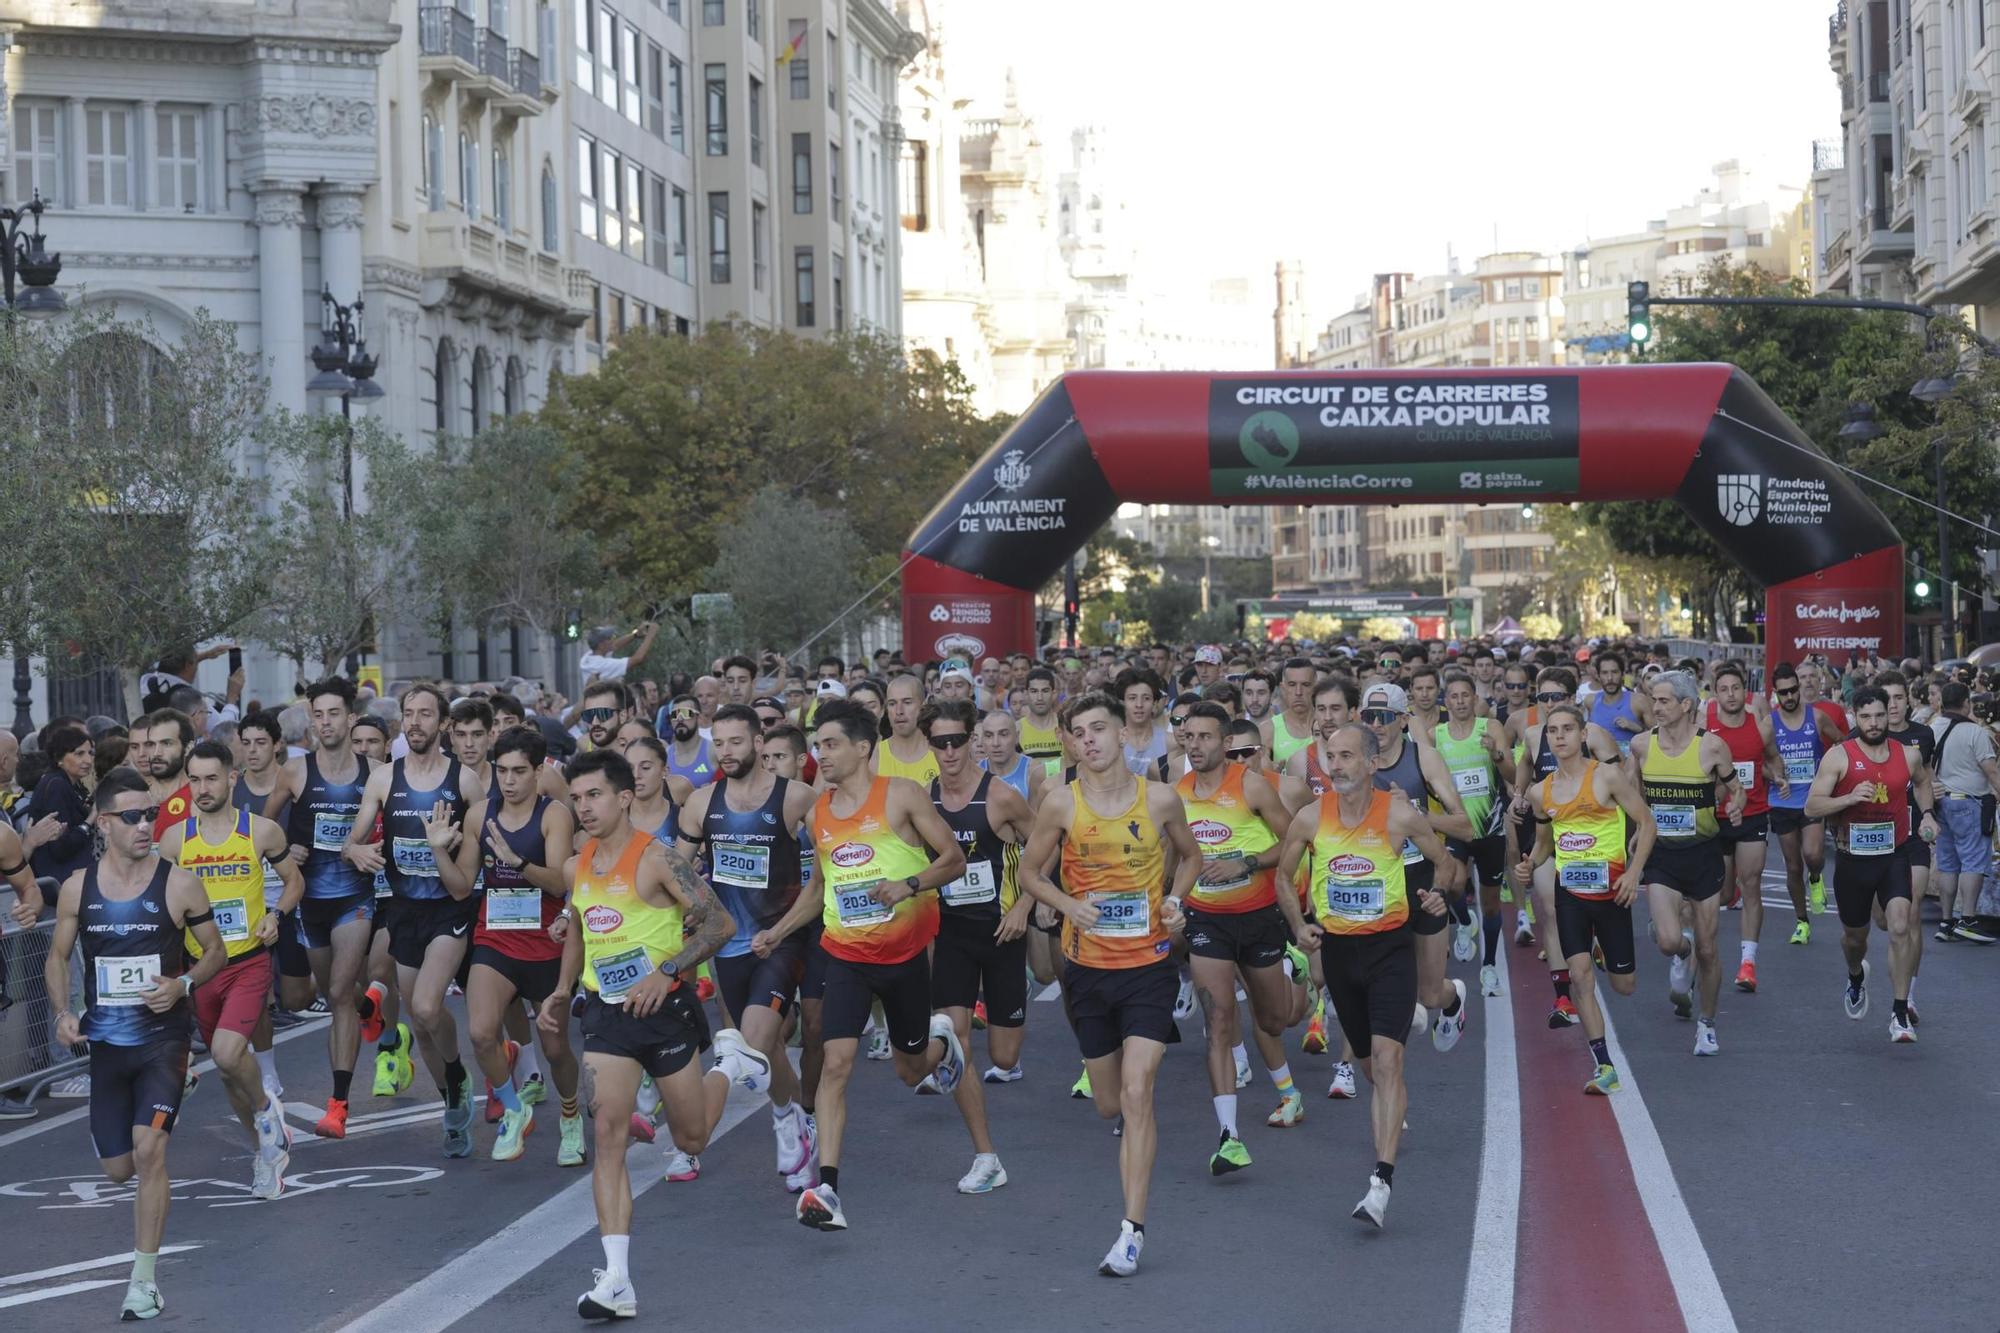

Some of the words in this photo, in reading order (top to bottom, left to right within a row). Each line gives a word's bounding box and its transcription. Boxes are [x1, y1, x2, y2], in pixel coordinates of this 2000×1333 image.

[1236, 387, 1345, 404] CIRCUIT
[1352, 386, 1389, 404] DE
[1394, 384, 1548, 403] CARRERES
[1416, 430, 1460, 442] CIUTAT
[1465, 430, 1484, 441] DE
[1244, 474, 1413, 489] #ValènciaCorre
[1485, 472, 1522, 481] caixa
[1485, 479, 1543, 488] popular
[1767, 478, 1826, 490] Fundació
[1767, 490, 1829, 502] Esportiva
[961, 498, 1066, 516] AJUNTAMENT
[1767, 502, 1831, 514] Municipal
[959, 518, 980, 532] DE
[985, 514, 1066, 532] VALÈNCIA
[1767, 513, 1823, 524] València
[1796, 604, 1808, 619] El
[1808, 604, 1839, 619] Corte
[951, 616, 991, 624] ALFONSO
[1807, 637, 1881, 649] INTERSPORT
[1780, 741, 1812, 751] POBLATS
[1464, 775, 1479, 785] 39
[1646, 787, 1704, 798] ORRECAMINOS
[1657, 815, 1685, 824] 2067
[743, 834, 776, 842] SPORT
[1194, 828, 1228, 838] errano
[1856, 834, 1885, 843] 2193
[400, 850, 432, 862] 2122
[835, 848, 871, 862] Serrano
[720, 854, 755, 870] 2200
[1332, 861, 1370, 872] Serrano
[1566, 871, 1598, 881] 2259
[1333, 891, 1370, 904] 2018
[87, 924, 114, 932] META
[124, 924, 159, 932] SPORT
[121, 968, 144, 984] 21
[602, 965, 639, 985] 2320
